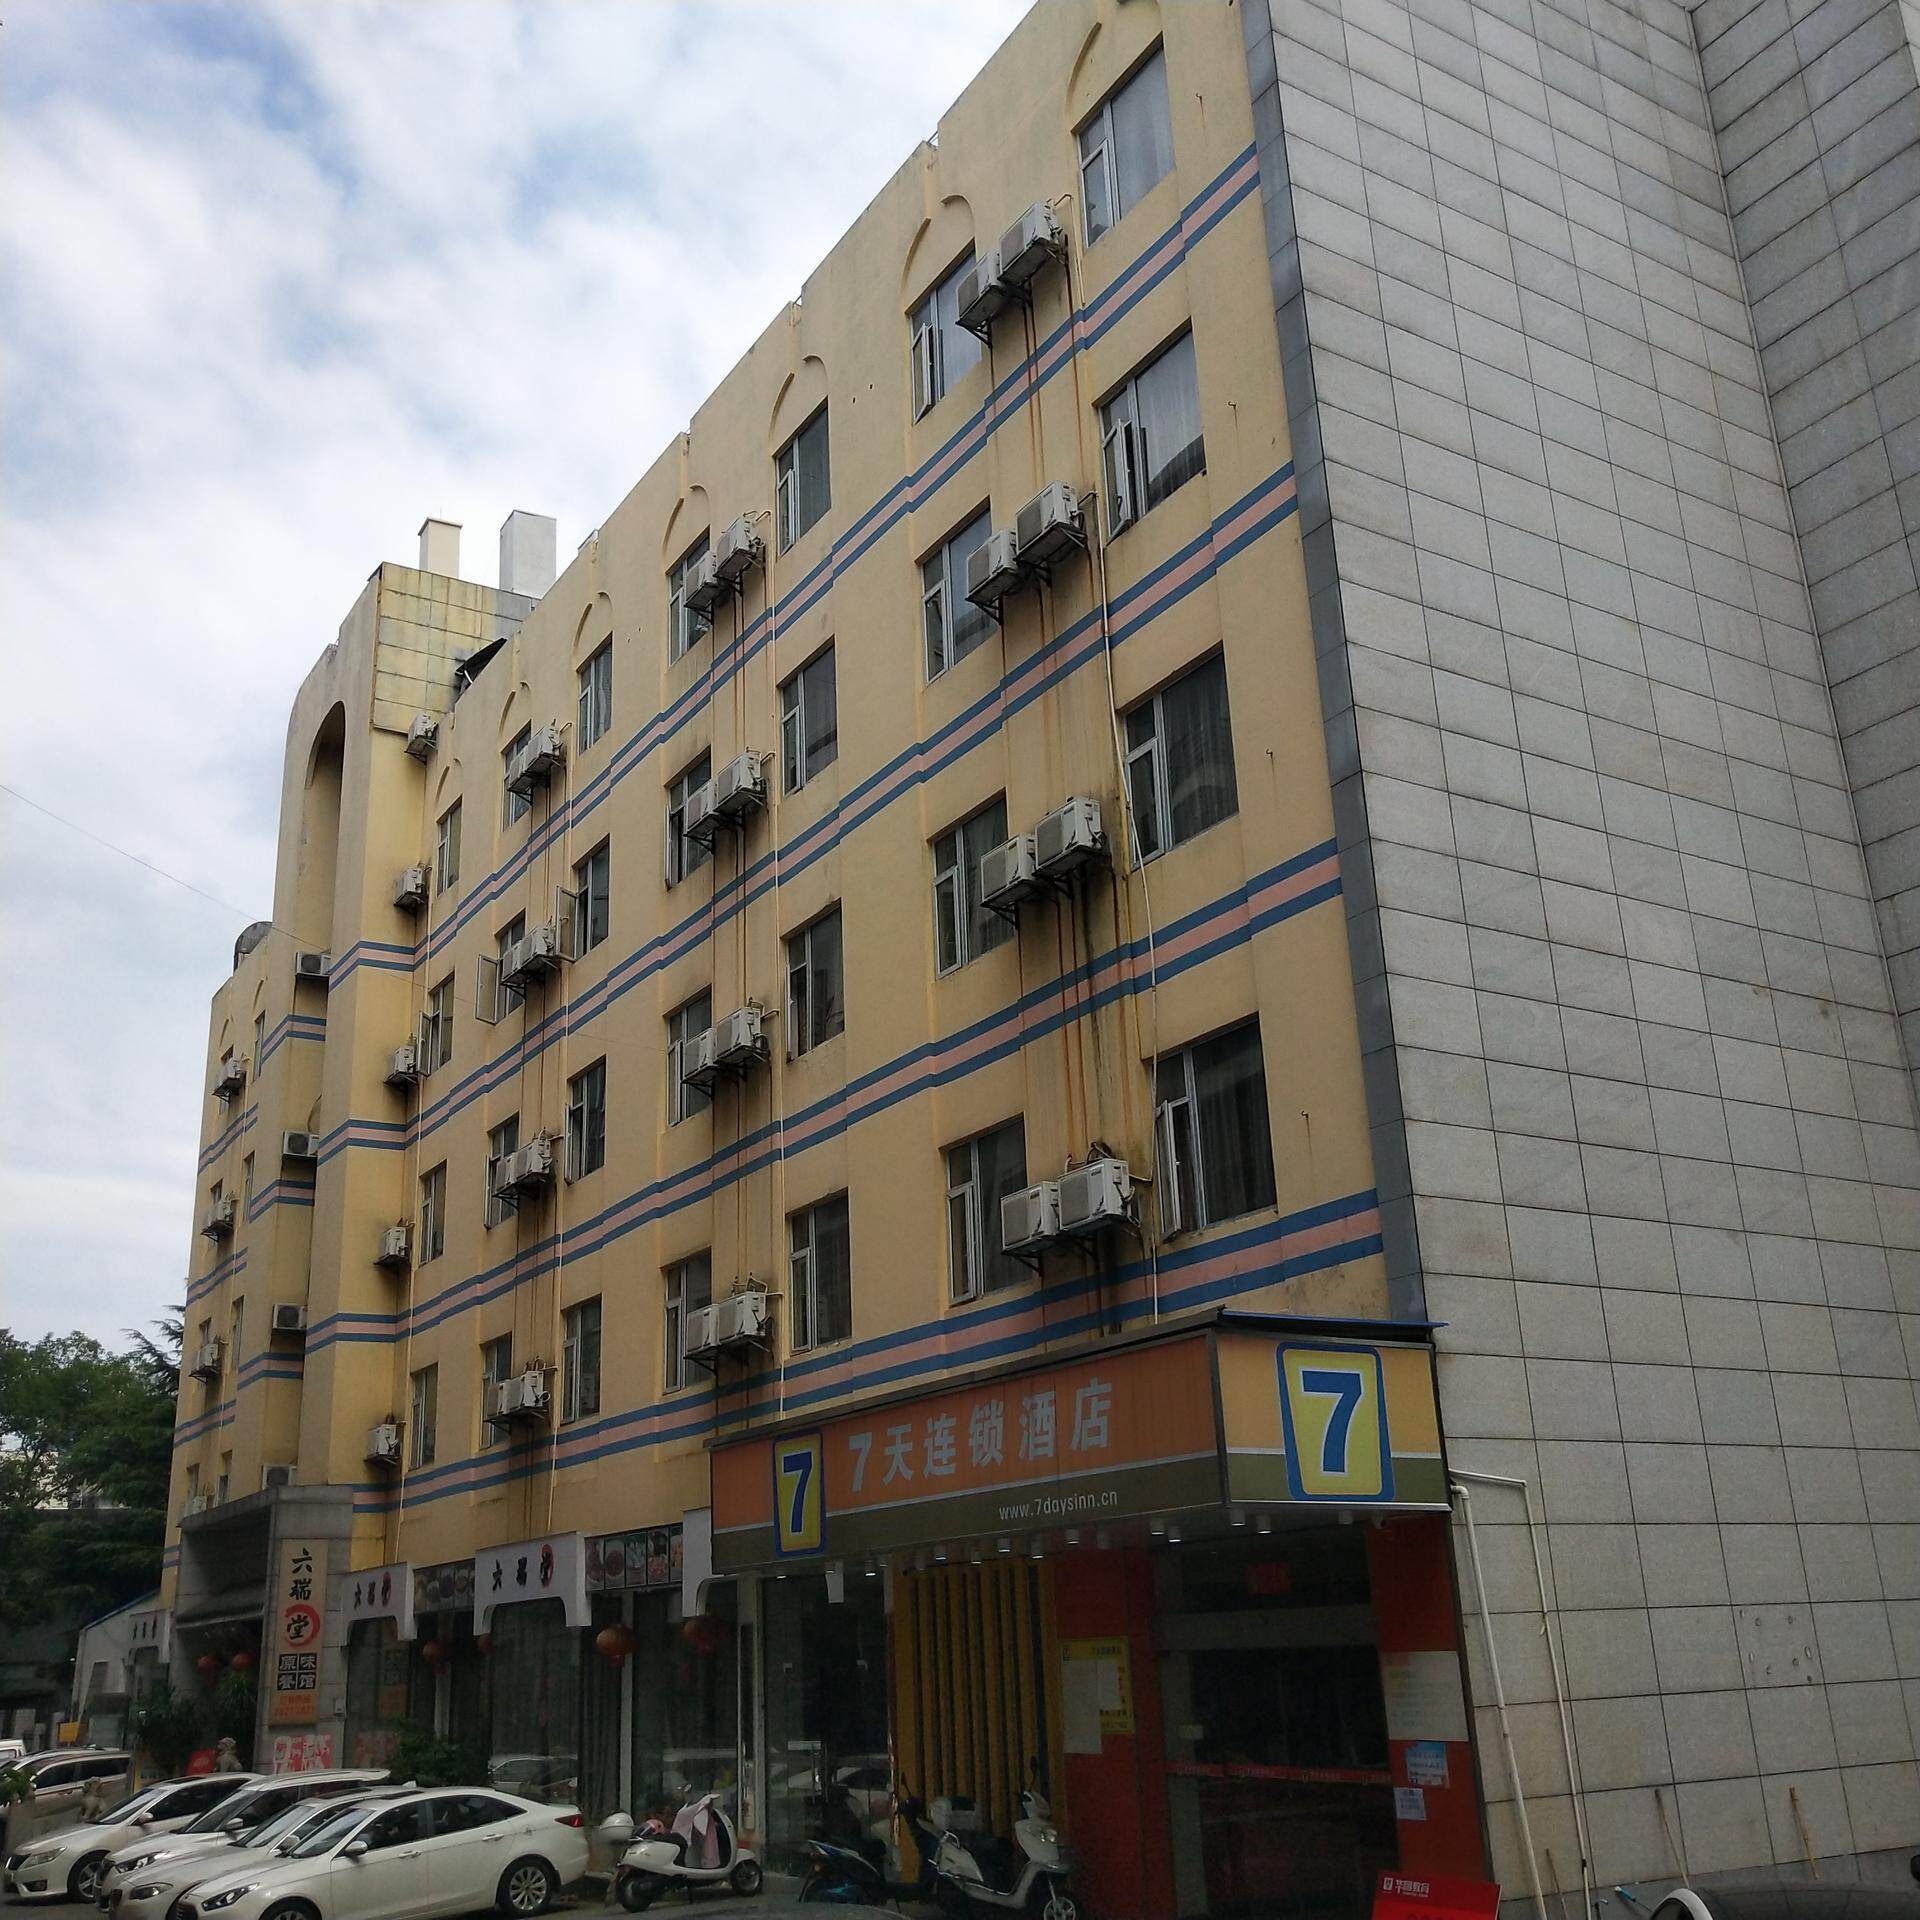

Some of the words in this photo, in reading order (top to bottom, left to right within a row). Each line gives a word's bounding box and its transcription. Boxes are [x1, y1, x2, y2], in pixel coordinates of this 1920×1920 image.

[850, 1377, 1112, 1493] 7天连锁酒店
[1301, 1369, 1363, 1474] 7
[781, 1449, 815, 1535] 7
[998, 1491, 1118, 1520] www.7daysinn.cn
[288, 1547, 313, 1639] 六瑞堂
[280, 1655, 316, 1670] 原味
